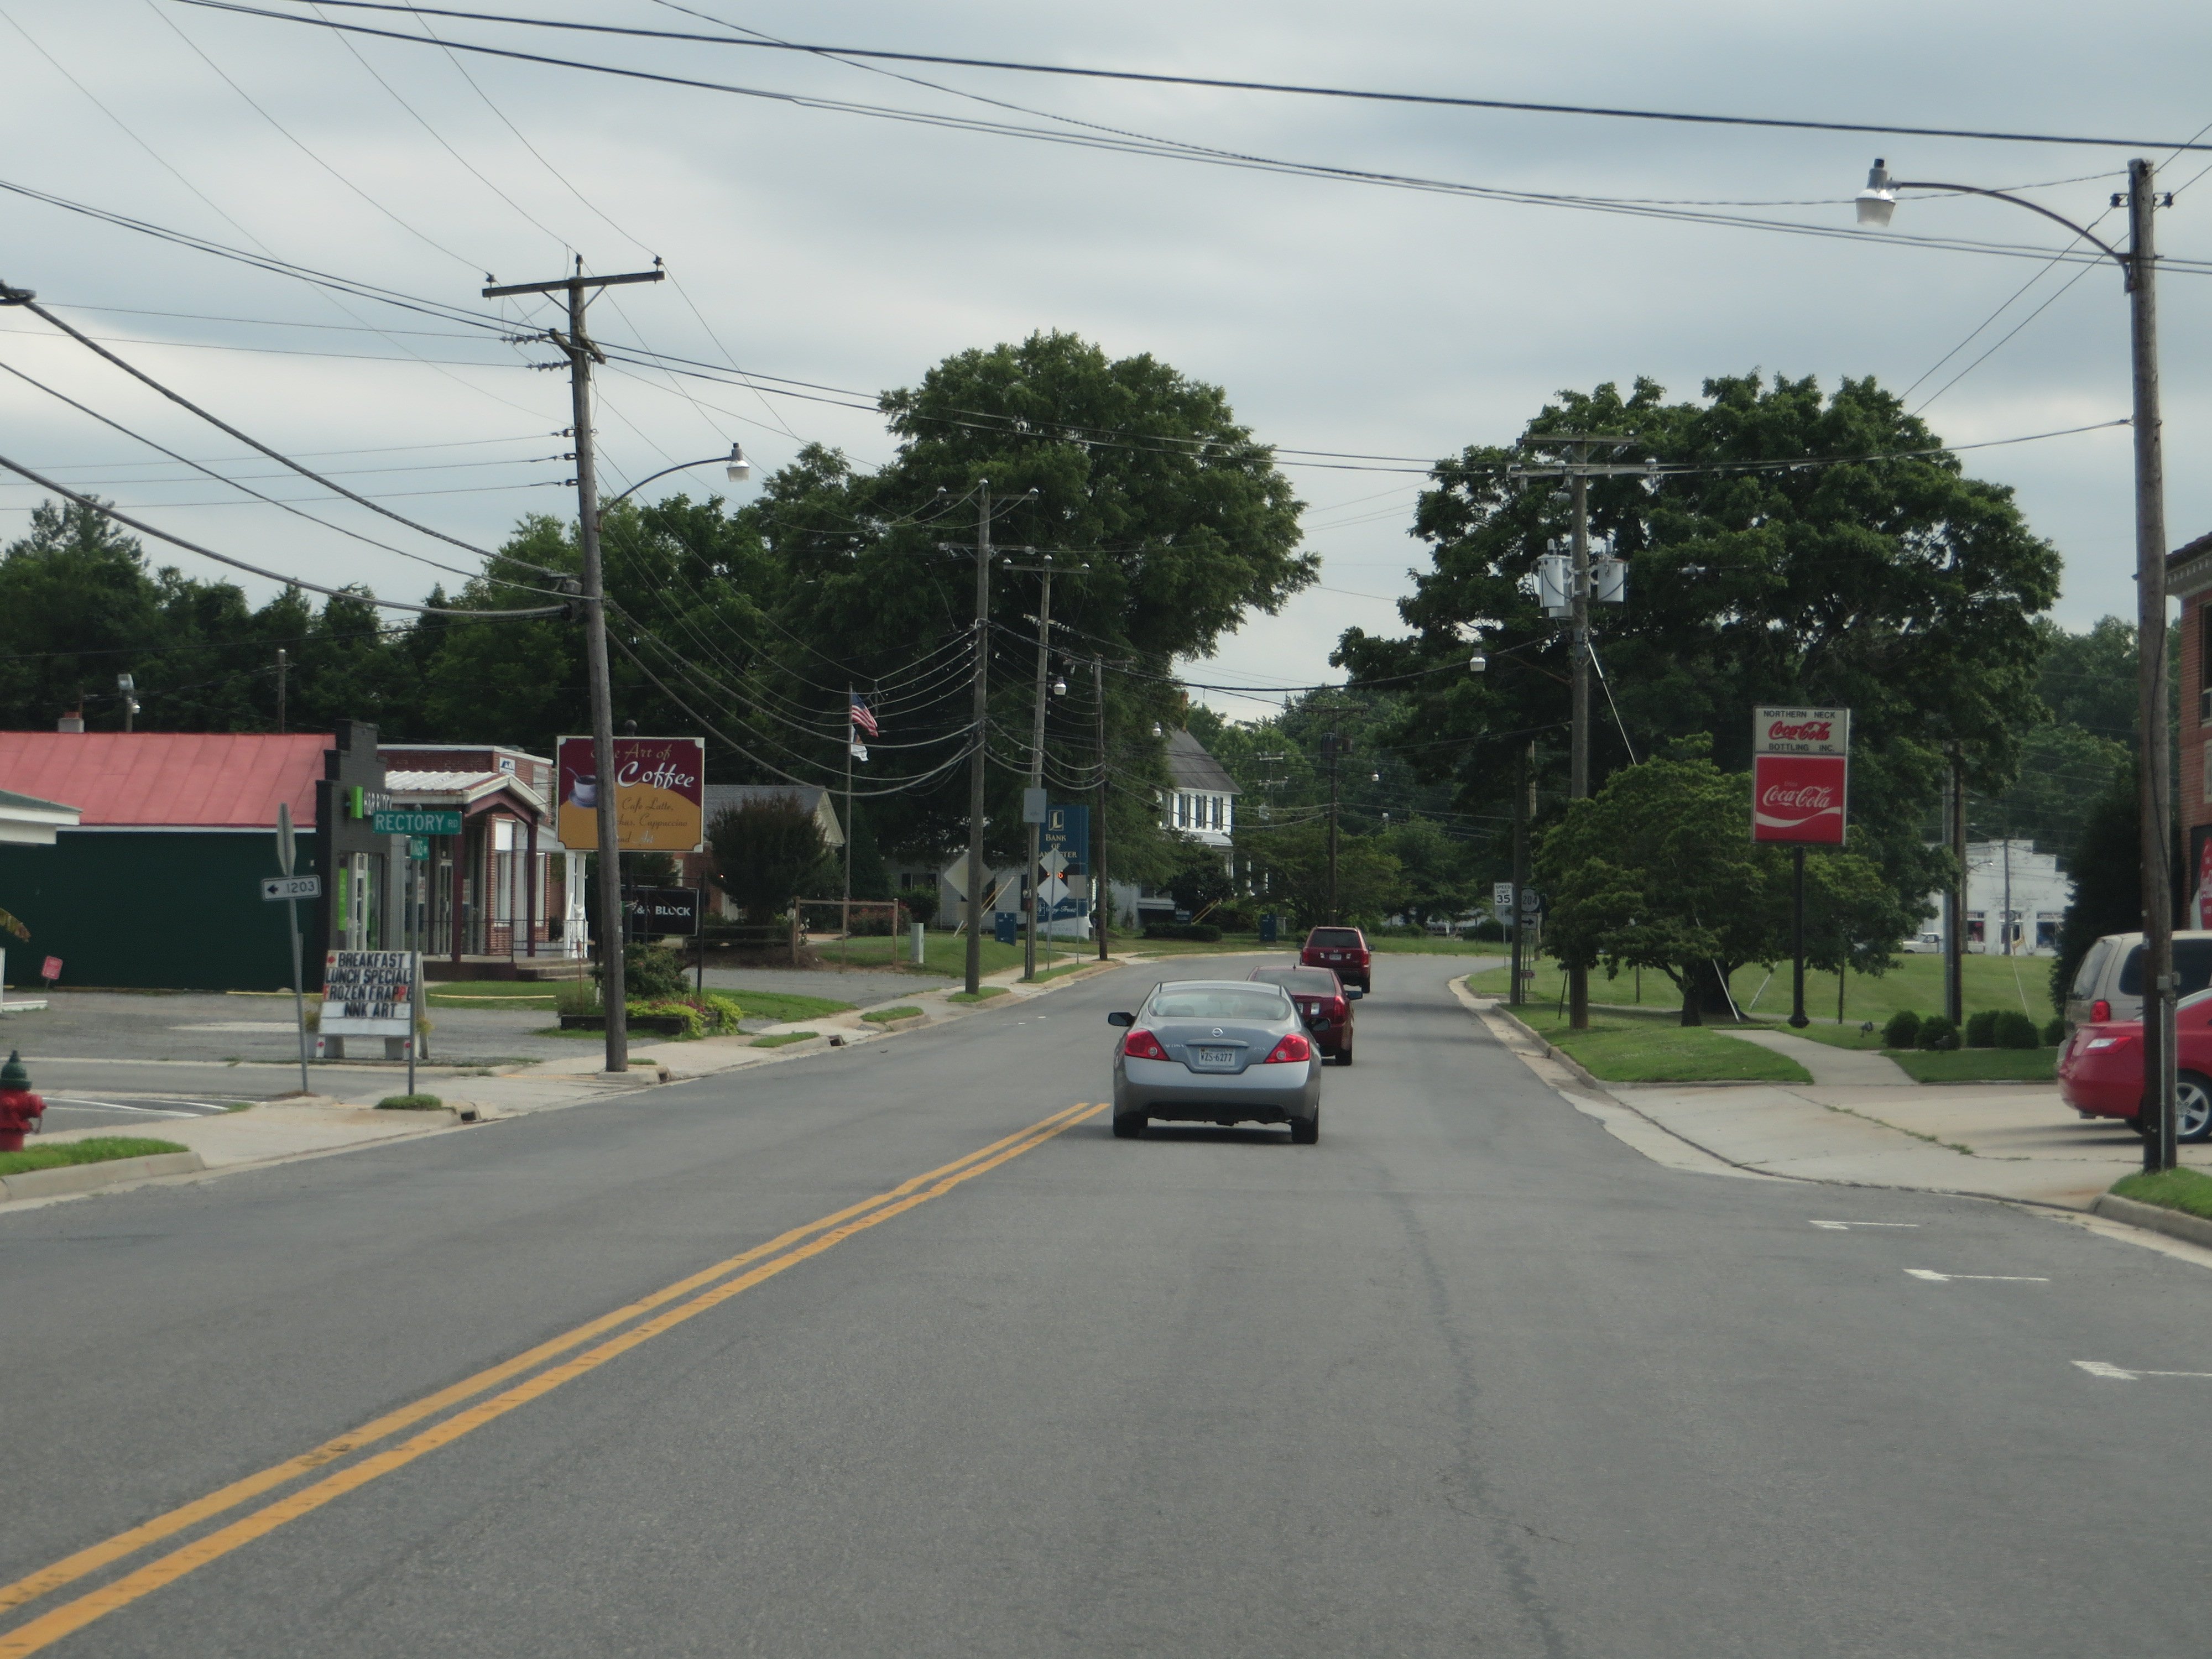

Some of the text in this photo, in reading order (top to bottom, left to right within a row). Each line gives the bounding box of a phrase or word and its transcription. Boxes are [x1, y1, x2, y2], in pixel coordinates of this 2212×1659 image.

[1768, 721, 1832, 741] Coca-Cola
[624, 742, 653, 761] Art
[656, 743, 673, 761] of
[1768, 743, 1809, 752] BOTTLING
[617, 761, 695, 790] Coffee
[622, 797, 642, 812] Cafe
[1762, 785, 1834, 808] Coca-Cola
[375, 814, 458, 831] RECTORY RD
[639, 813, 688, 830] Cappuccino
[1045, 833, 1067, 842] BANK
[286, 881, 315, 894] 1203
[1496, 894, 1511, 904] 35
[1522, 895, 1537, 905] 204
[338, 952, 405, 968] BREAKFAST
[326, 968, 360, 984] LUNCH
[323, 985, 367, 1000] FROZEN
[344, 1002, 398, 1018] NNK ART
